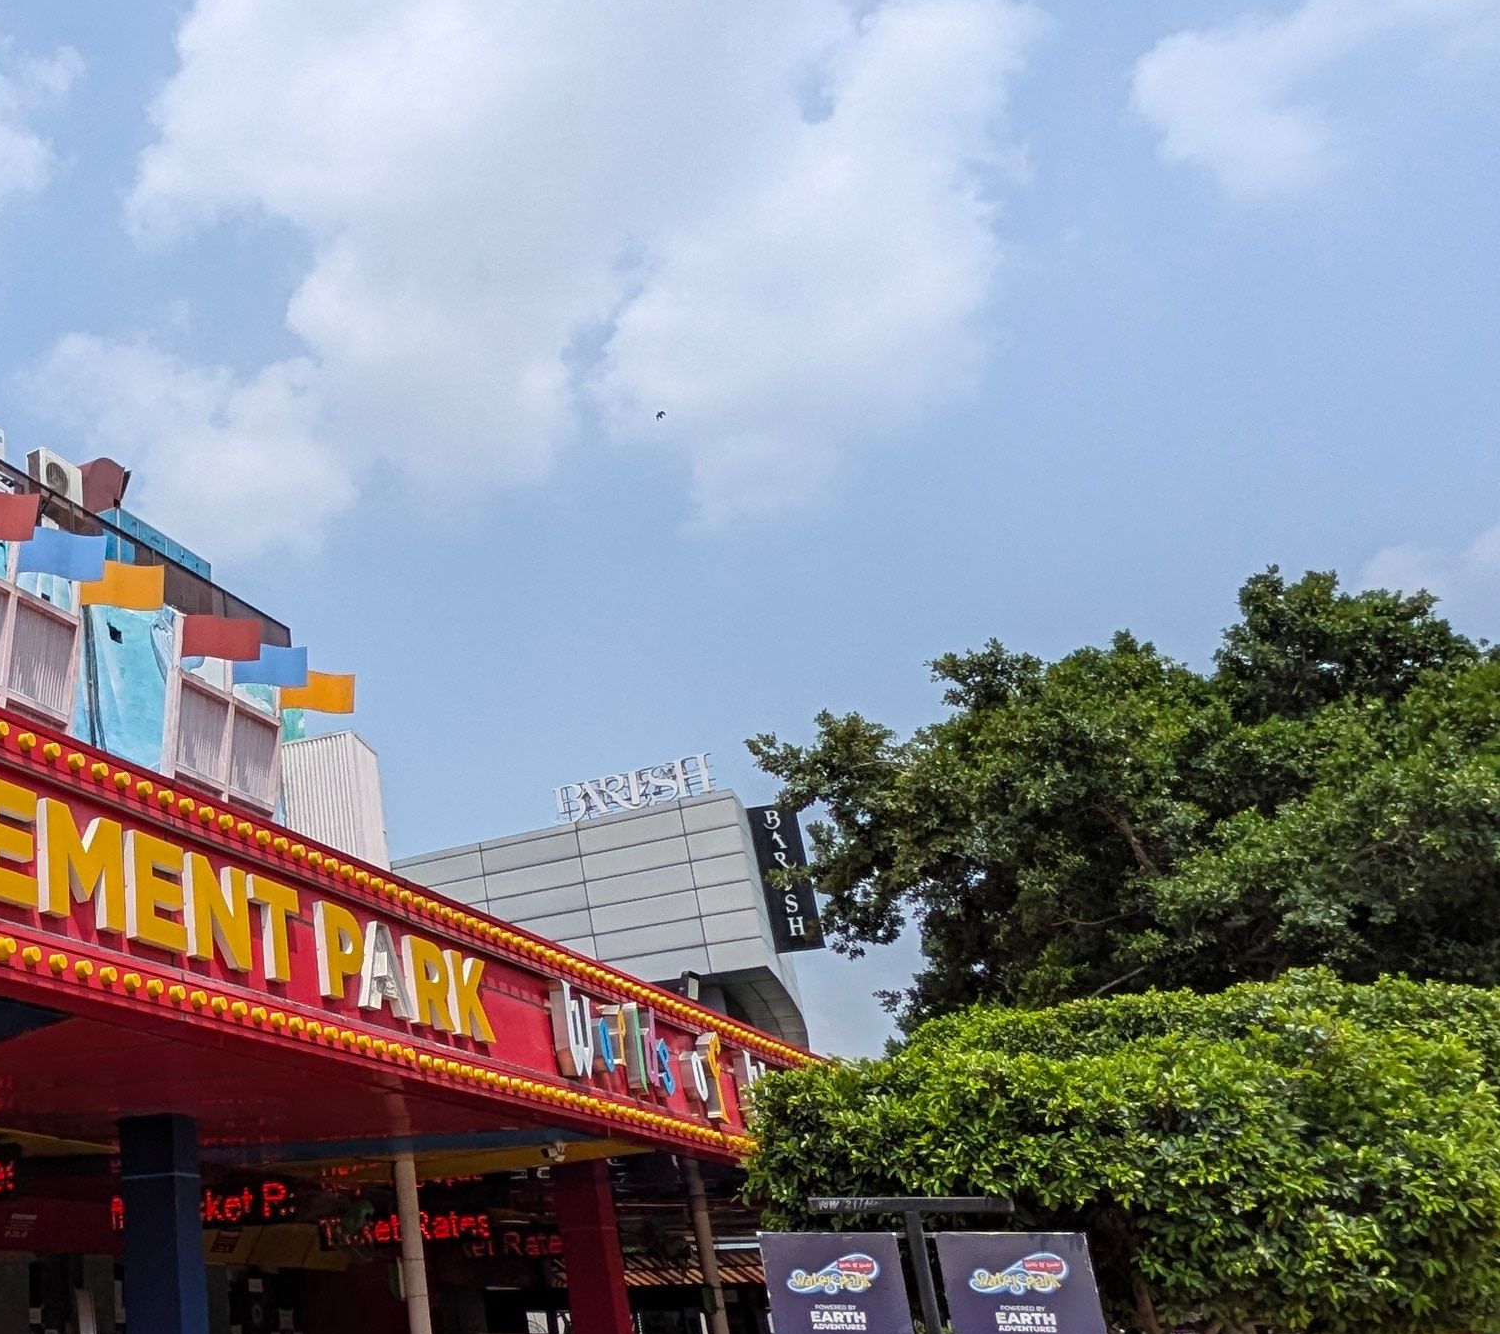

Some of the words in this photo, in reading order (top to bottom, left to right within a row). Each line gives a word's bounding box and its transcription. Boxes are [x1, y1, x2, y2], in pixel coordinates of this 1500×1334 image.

[763, 809, 805, 937] BARSH
[314, 900, 496, 1045] PARK
[810, 1310, 867, 1323] EARTH
[995, 1312, 1058, 1325] EARTH
[812, 1323, 867, 1331] ADVENTURES
[998, 1325, 1058, 1333] ADVENTURES
